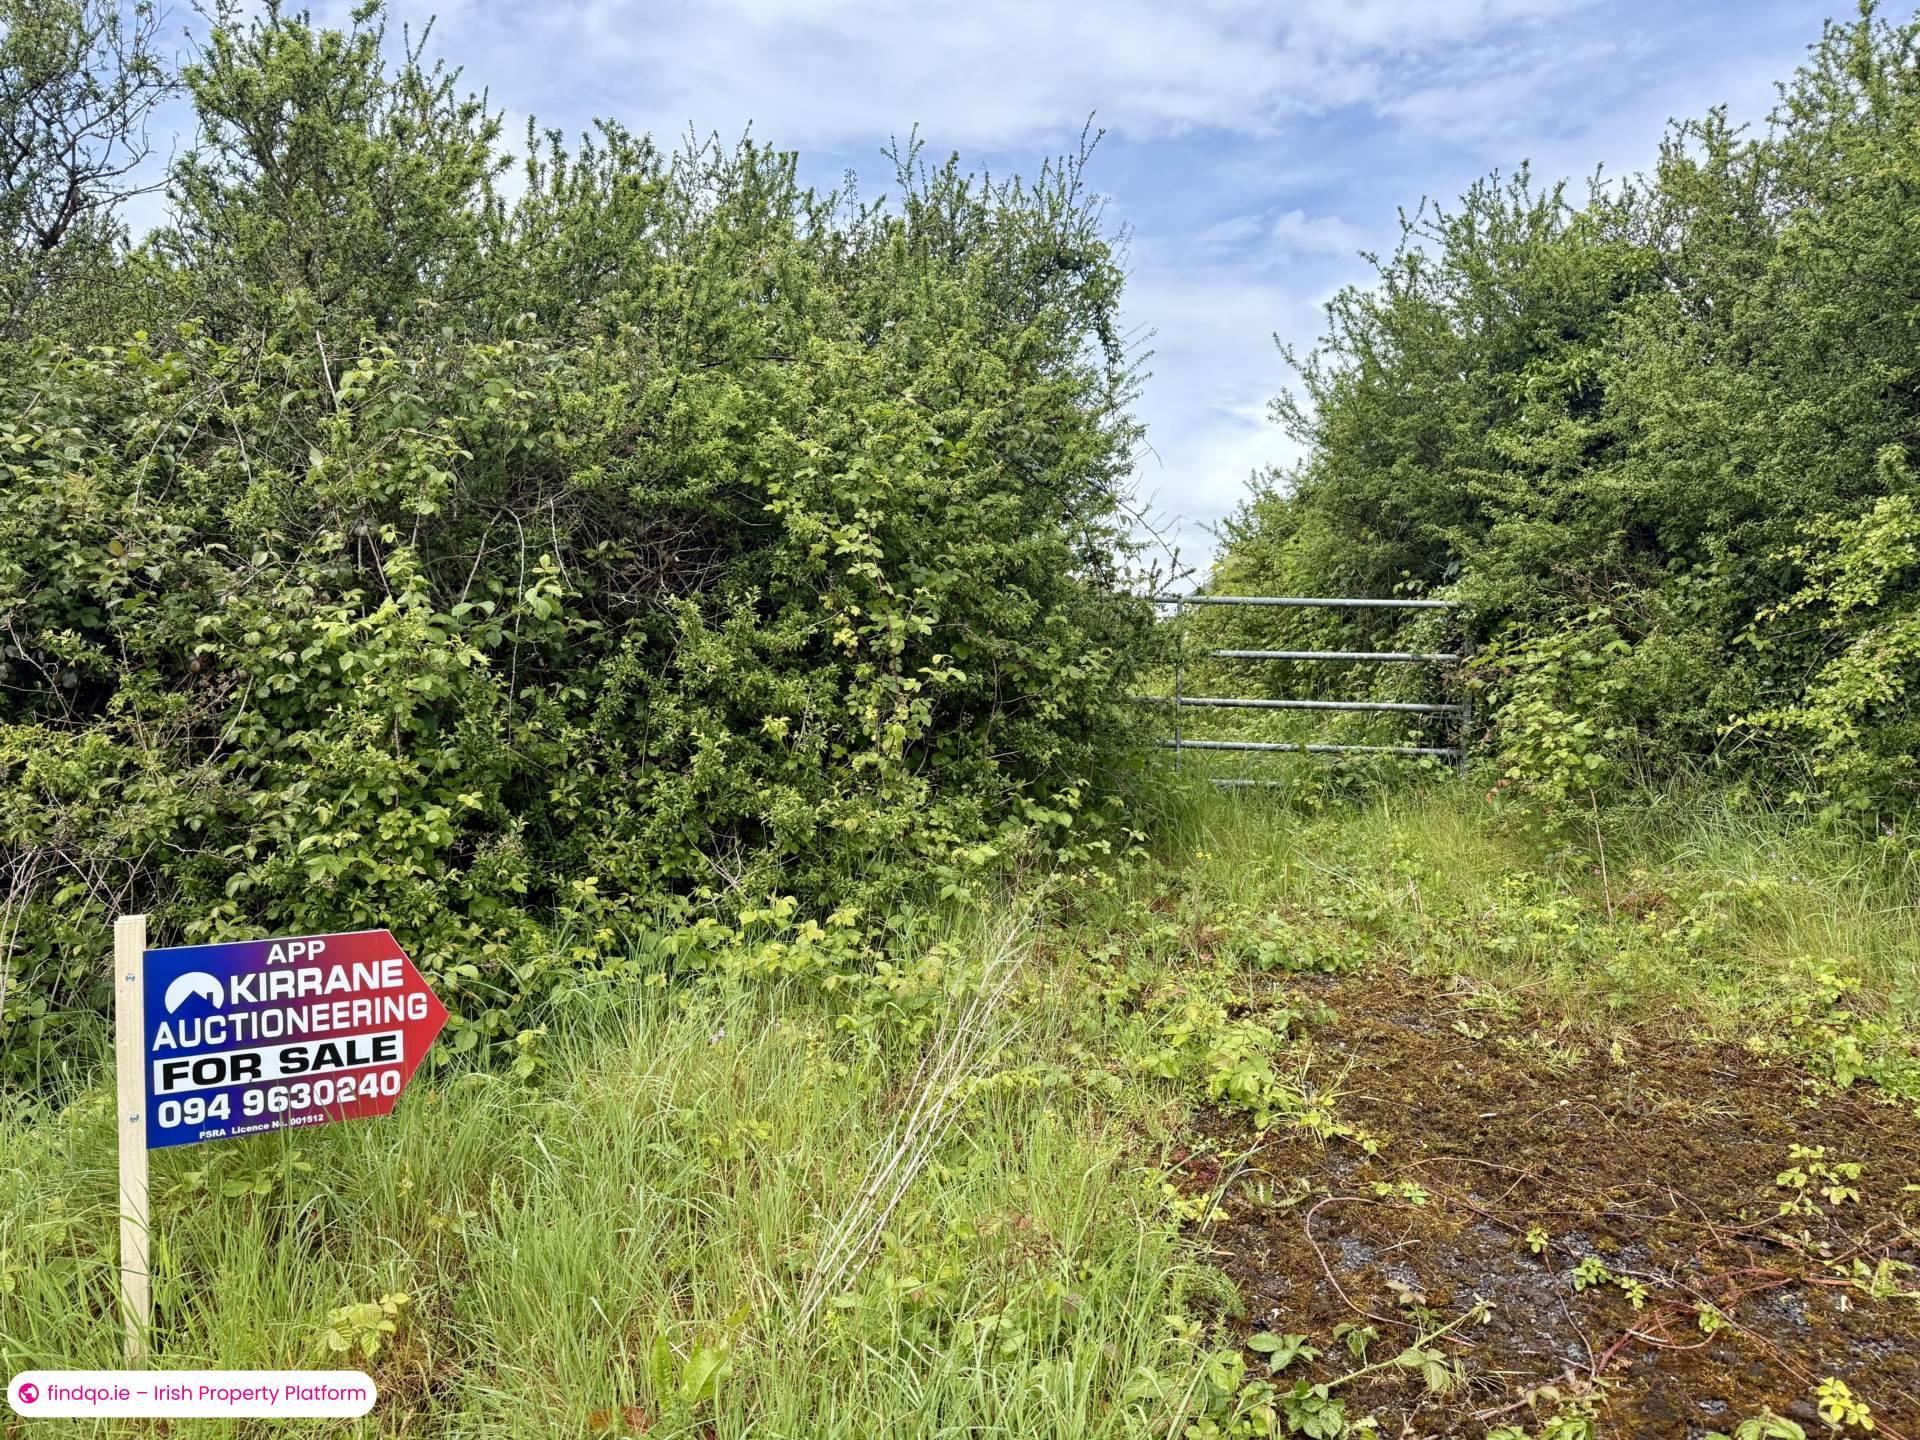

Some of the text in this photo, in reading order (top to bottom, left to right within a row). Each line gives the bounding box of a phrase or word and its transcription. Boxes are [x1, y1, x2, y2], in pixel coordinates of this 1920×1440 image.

[266, 940, 326, 965] APP
[230, 958, 404, 1005] KIRRANE
[152, 992, 428, 1051] AUCTIONEERING
[162, 1034, 397, 1090] FOR SALE
[158, 1069, 401, 1128] 094 9630240
[199, 1129, 226, 1139] PSRA
[232, 1124, 269, 1134] Licence
[290, 1114, 324, 1126] 001512
